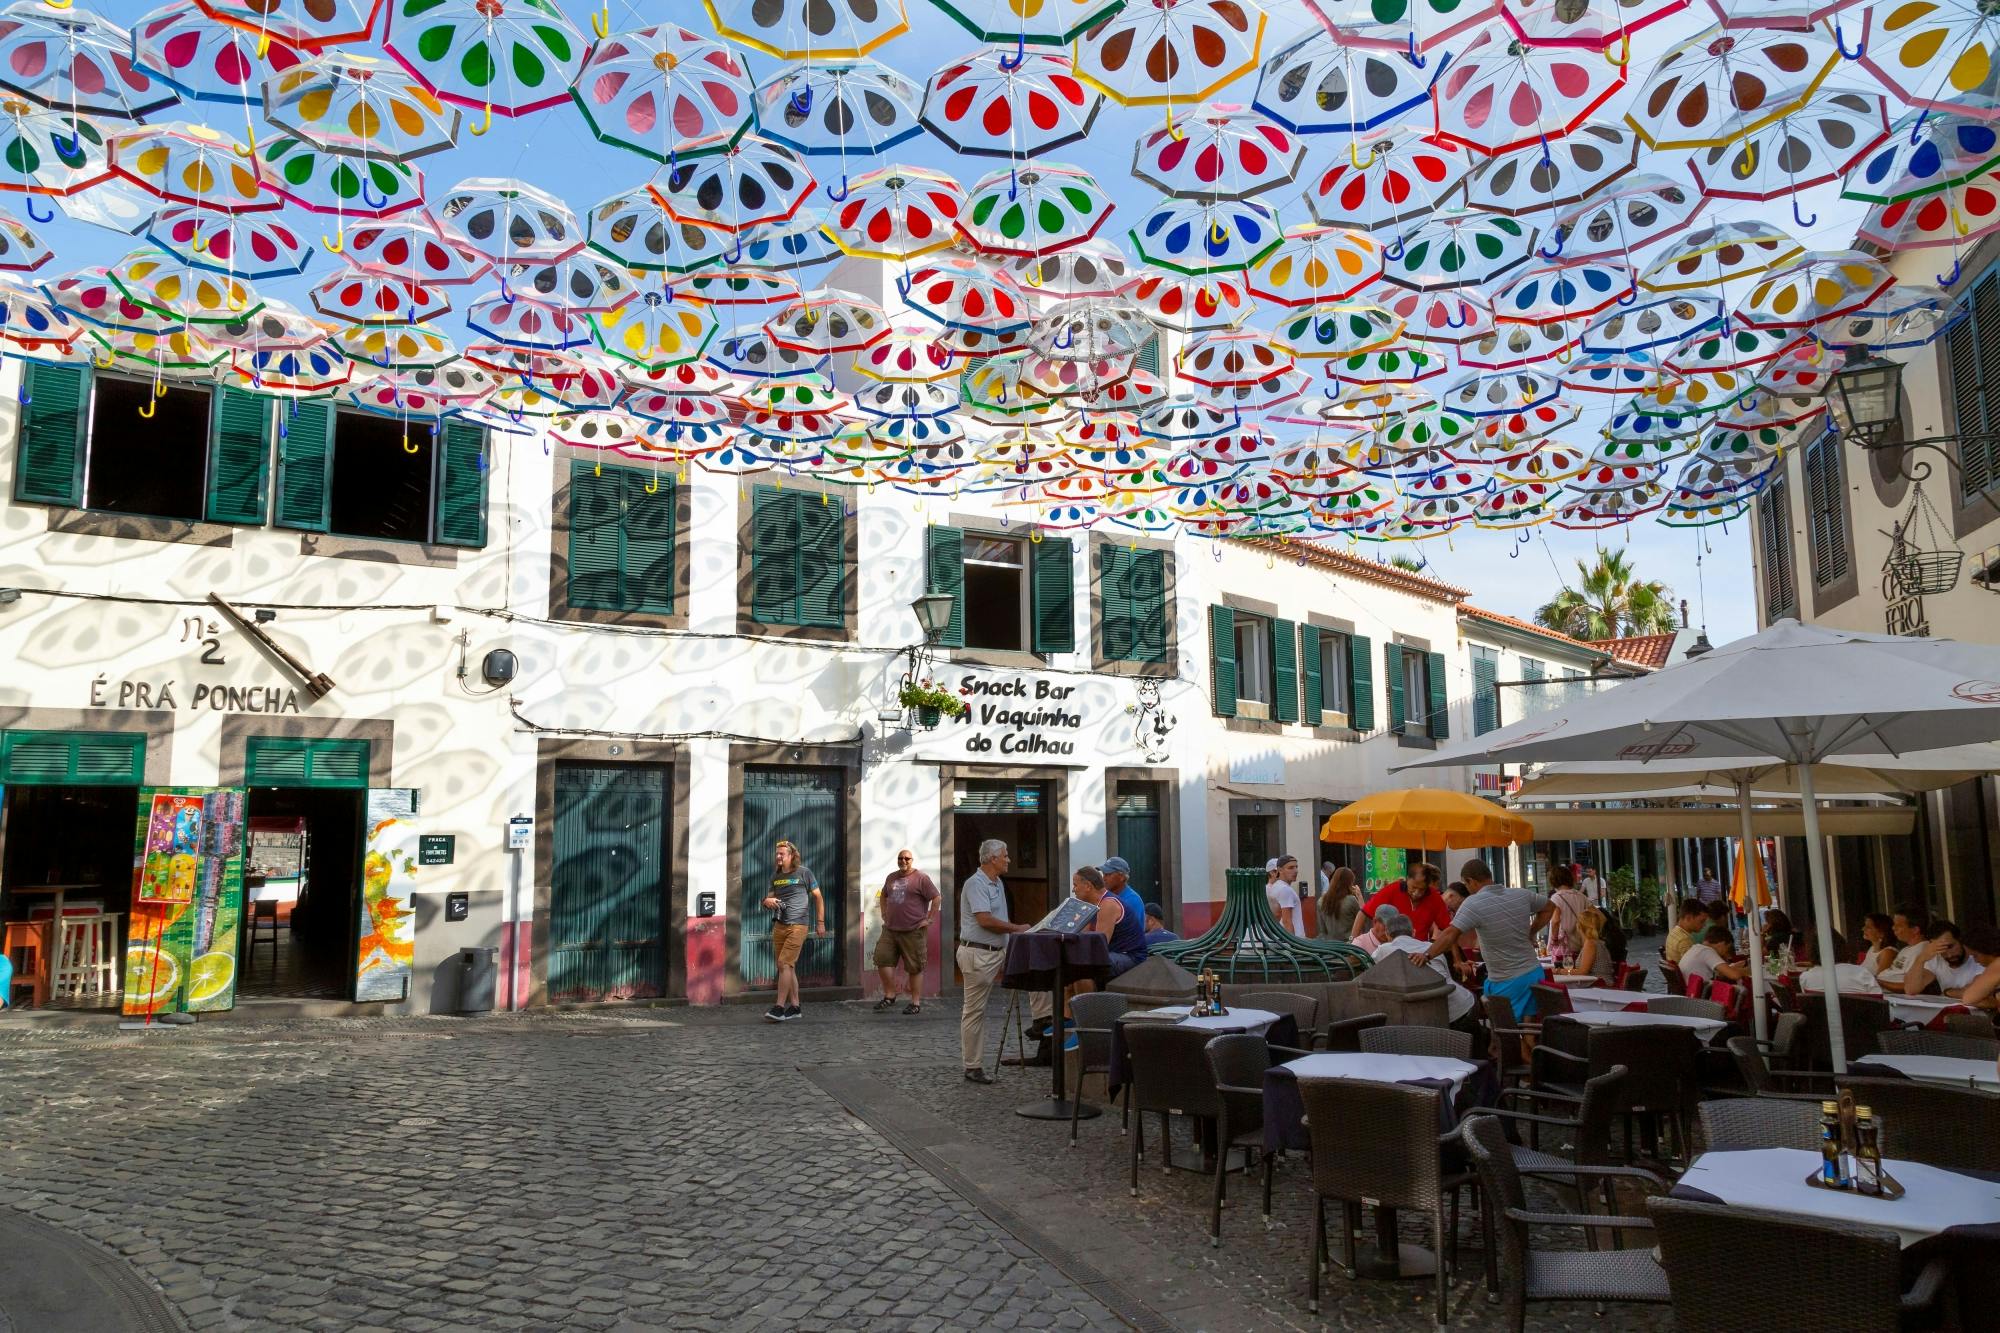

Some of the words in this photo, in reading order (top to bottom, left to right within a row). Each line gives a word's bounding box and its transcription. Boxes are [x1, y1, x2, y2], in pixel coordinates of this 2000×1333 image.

[1886, 595, 1925, 635] FAROL
[201, 638, 226, 665] 2
[90, 672, 108, 707] É
[118, 680, 177, 709] PRÁ
[190, 682, 300, 714] PONCHA
[961, 675, 1027, 698] Snack
[1035, 679, 1076, 700] Bar
[981, 704, 1082, 731] Vaquinha
[965, 732, 993, 752] do
[1000, 733, 1075, 755] Calhau
